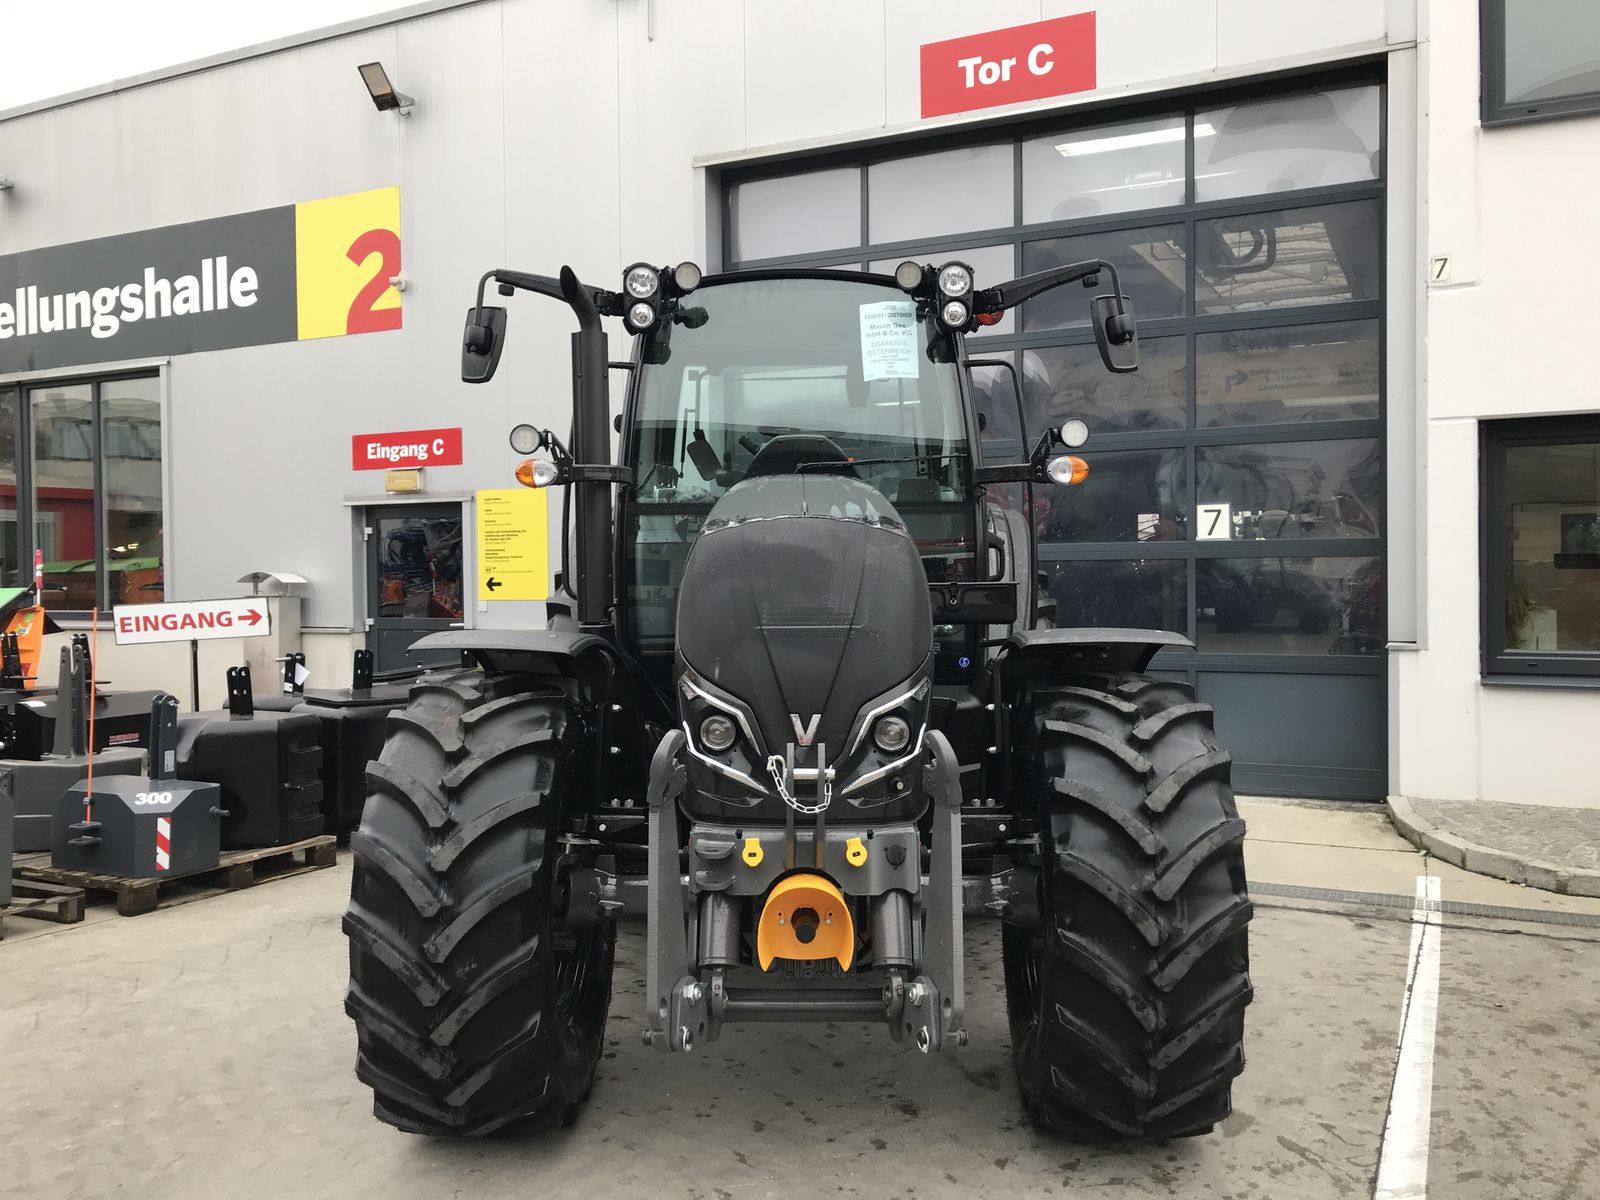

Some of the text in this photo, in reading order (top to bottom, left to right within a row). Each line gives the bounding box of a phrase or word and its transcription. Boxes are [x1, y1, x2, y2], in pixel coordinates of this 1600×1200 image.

[957, 43, 1054, 88] Tor C
[1434, 257, 1448, 280] 7
[346, 228, 403, 336] 2
[865, 331, 881, 339] mbH
[366, 438, 445, 463] Eingang C
[1203, 509, 1222, 536] 7
[120, 610, 233, 633] EINGANG
[134, 791, 173, 806] 300
